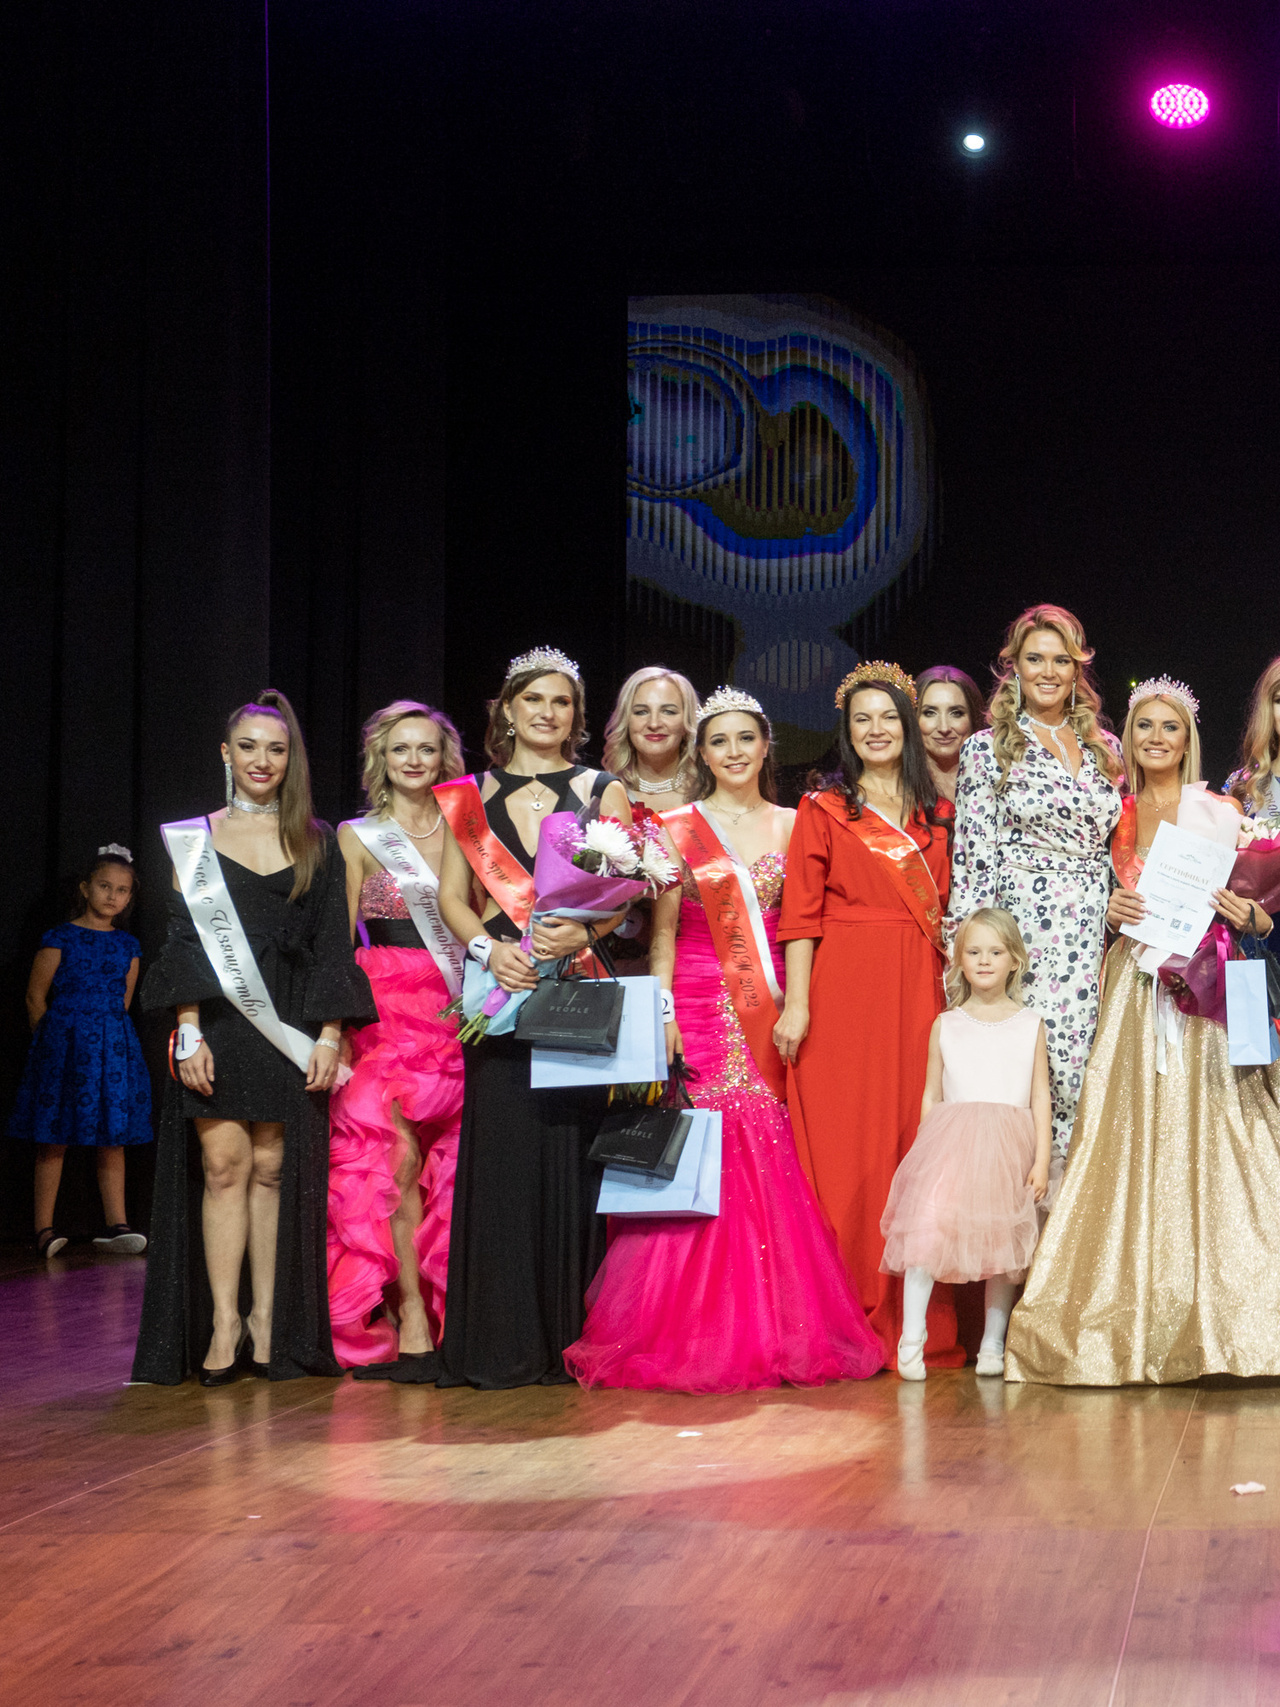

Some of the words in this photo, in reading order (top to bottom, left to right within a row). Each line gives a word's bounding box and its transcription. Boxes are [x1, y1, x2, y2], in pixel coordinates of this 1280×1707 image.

[377, 832, 420, 878] Миссис
[413, 882, 464, 981] Аристократ
[209, 909, 266, 1018] Изящество
[739, 977, 760, 1008] 2022
[549, 1005, 590, 1014] PEOPLE
[620, 1128, 653, 1139] PEOPLE
